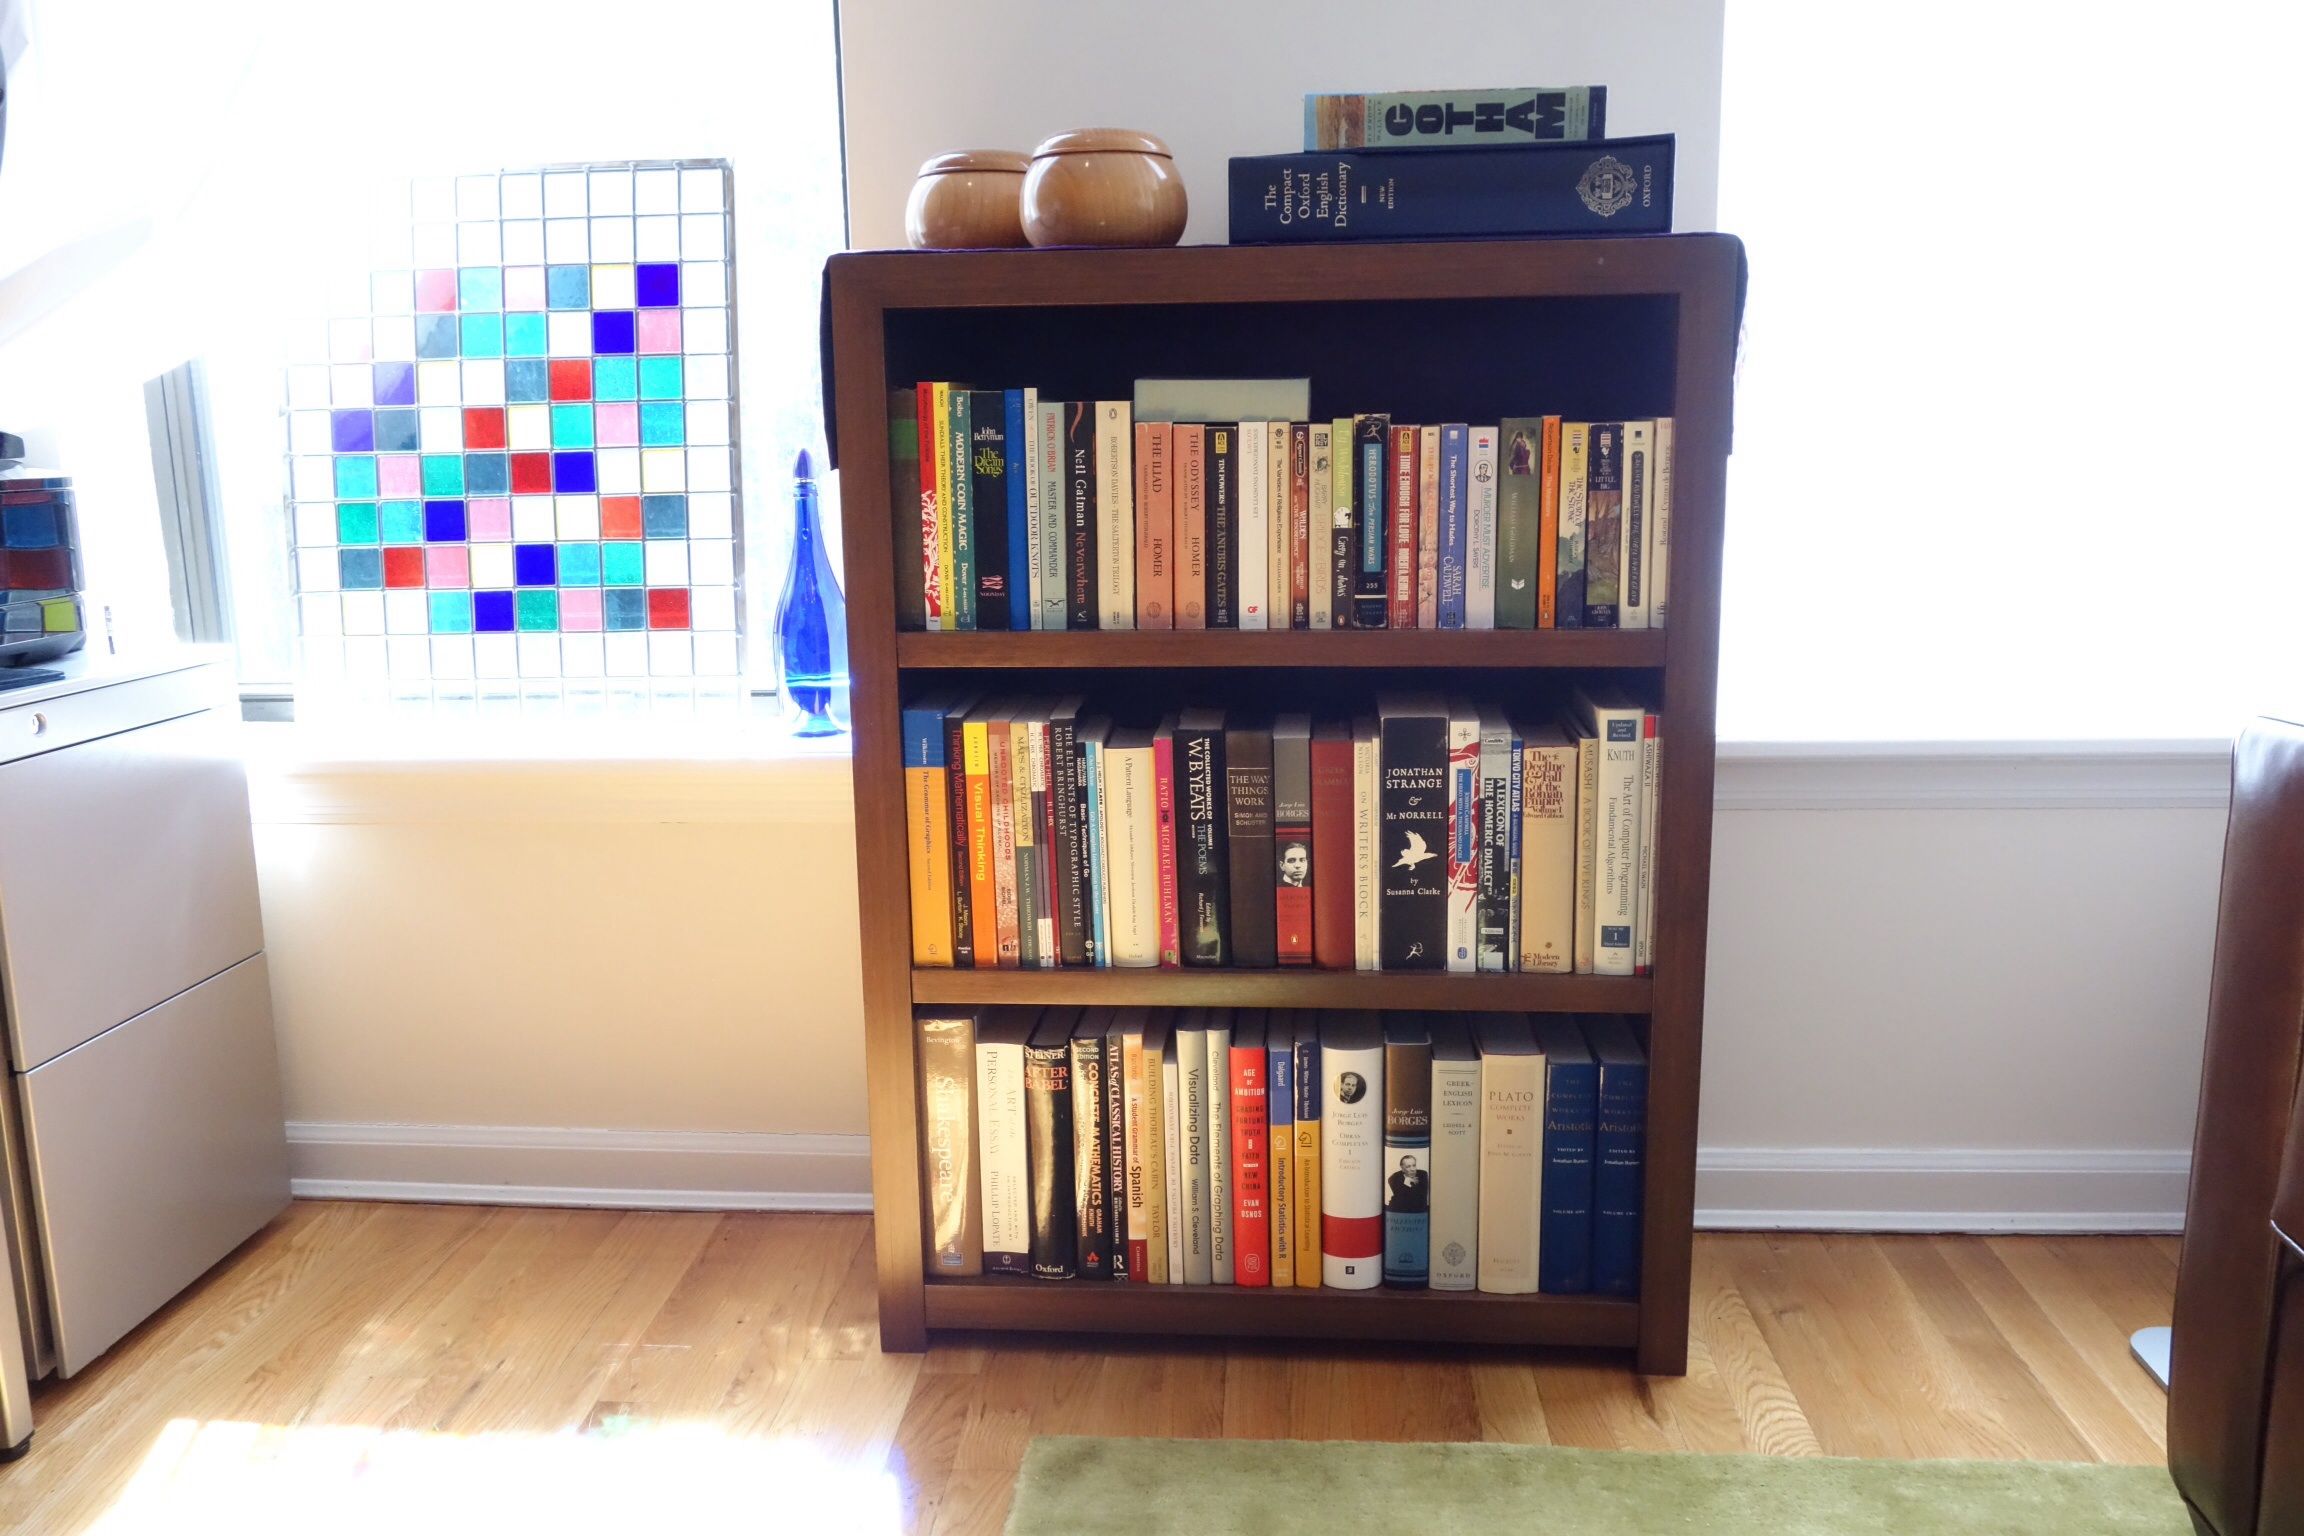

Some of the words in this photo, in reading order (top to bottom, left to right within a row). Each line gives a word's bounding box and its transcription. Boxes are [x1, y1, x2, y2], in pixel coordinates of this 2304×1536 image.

[1385, 92, 1566, 139] GOTHAM
[1265, 185, 1277, 209] The
[1280, 169, 1296, 224] Compact
[1298, 173, 1310, 218] Oxford
[1316, 172, 1332, 218] English
[1335, 162, 1351, 227] Dictionary
[1643, 165, 1652, 207] OXFORD
[956, 396, 964, 417] Bobo
[955, 432, 965, 480] MODERN
[1152, 434, 1162, 459] THE
[1190, 433, 1199, 456] THE
[1074, 449, 1086, 474] Neil
[1152, 461, 1162, 493] ILIAD
[1399, 455, 1410, 474] TIME
[957, 483, 966, 511] COIN
[1048, 481, 1057, 510] MASTER
[1190, 460, 1200, 511] ODYSSEY
[1218, 474, 1226, 504] POWERS
[1399, 474, 1410, 506] ENOUGH
[1568, 481, 1576, 494] THE
[1076, 479, 1087, 527] Gaiman
[1216, 507, 1226, 527] THE
[1399, 509, 1410, 523] FOR
[1448, 501, 1456, 514] Way
[1482, 488, 1492, 525] MURDER
[1567, 496, 1576, 522] STONE
[959, 513, 967, 551] MAGIC
[1049, 513, 1057, 528] AND
[1398, 525, 1410, 544] LOVE
[1216, 529, 1227, 571] ANUBIS
[1482, 527, 1491, 546] MUST
[1049, 531, 1058, 578] COMMANDER
[1076, 532, 1088, 603] Neverwhere
[1153, 538, 1163, 577] HOMER
[1191, 537, 1201, 577] HOMER
[1481, 548, 1490, 589] ADVERTISE
[1217, 572, 1227, 607] GATES
[1442, 556, 1452, 605] CAUDWELL
[1452, 565, 1462, 595] SARAH
[951, 729, 963, 770] Thinking
[1017, 736, 1025, 763] MAPS
[1054, 727, 1064, 767] ROBERT
[1065, 726, 1073, 747] THE
[1188, 739, 1203, 756] W.
[1018, 766, 1025, 774] &
[1188, 761, 1203, 774] B.
[1512, 748, 1521, 771] TOKYO
[1531, 751, 1551, 761] The
[1607, 749, 1635, 761] KNUTH
[1066, 750, 1075, 802] ELEMENTS
[1125, 763, 1134, 786] Pattern
[1230, 776, 1249, 784] THE
[1251, 775, 1270, 783] WAY
[1386, 768, 1443, 779] JONATHAN
[1386, 779, 1442, 789] STRANGE
[1484, 778, 1494, 798] THE
[1497, 779, 1505, 787] A
[1512, 773, 1521, 789] CITY
[1623, 775, 1633, 792] The
[922, 784, 931, 815] Grammar
[974, 782, 984, 822] Visual
[1056, 770, 1067, 837] BRINGHURST
[1125, 787, 1134, 818] Language
[1160, 777, 1169, 808] RATIO
[1189, 775, 1205, 820] YEATS
[1231, 786, 1269, 795] THINGS
[1361, 791, 1367, 805] ON
[1512, 790, 1520, 812] ATLAS
[1623, 793, 1632, 808] Art
[954, 772, 966, 847] Mathematically
[1019, 776, 1030, 842] CIVILIZATION
[1068, 805, 1076, 820] OF
[1399, 812, 1443, 820] NORRELL
[1484, 800, 1494, 845] HOMERIC
[1496, 789, 1505, 831] LEXICON
[1607, 797, 1617, 849] Fundamental
[1623, 809, 1632, 818] of
[924, 825, 933, 854] Graphics
[1160, 824, 1171, 871] MICHAEL
[1197, 825, 1206, 842] THE
[1358, 809, 1369, 871] WRITER'S
[1495, 834, 1504, 847] OF
[1620, 819, 1632, 860] Computer
[975, 827, 986, 881] Thinking
[1068, 822, 1079, 895] TYPOGRAPHIC
[1198, 843, 1207, 874] POEMS
[1483, 848, 1493, 886] DIALECT
[1410, 877, 1419, 886] by
[1606, 851, 1616, 894] Algorithms
[1162, 874, 1173, 924] RUHLMAN
[1359, 875, 1369, 919] BLOCK
[1386, 888, 1415, 896] Susanna
[1617, 862, 1631, 916] Programming
[1072, 897, 1082, 928] STYLE
[1025, 1066, 1068, 1078] AFTER
[1109, 1044, 1120, 1078] ATLAS
[1211, 1051, 1220, 1091] Cleveland
[1243, 1069, 1255, 1077] AGE
[1276, 1061, 1286, 1087] Dalgaard
[1025, 1079, 1067, 1090] BABEL
[1087, 1062, 1099, 1123] CONCRETE
[1109, 1078, 1120, 1087] of
[1147, 1057, 1157, 1105] BUILDING
[1235, 1088, 1265, 1096] AMBITION
[1489, 1091, 1534, 1102] PLATO
[1110, 1087, 1122, 1145] CLASSICAL
[1131, 1103, 1139, 1126] Student
[1188, 1068, 1200, 1133] Visualizing
[1212, 1102, 1222, 1120] The
[1149, 1107, 1159, 1159] THOREAU'S
[1387, 1115, 1428, 1126] BORGES
[931, 1076, 956, 1203] Shakespeare
[1190, 1135, 1200, 1165] Data
[1212, 1122, 1223, 1169] Elements
[1090, 1127, 1102, 1206] MATHEMATICS
[1112, 1146, 1123, 1193] HISTORY
[1150, 1161, 1159, 1190] CABIN
[1213, 1172, 1224, 1182] of
[1277, 1157, 1287, 1202] Introductory
[990, 1170, 999, 1209] PHILLIP
[1129, 1165, 1144, 1208] Spanish
[1191, 1178, 1199, 1205] William
[1151, 1203, 1161, 1239] TAYLOR
[1211, 1185, 1225, 1234] Graphing
[1278, 1203, 1287, 1236] Statistics
[991, 1210, 1001, 1247] LOPATE
[1192, 1215, 1200, 1255] Cleveland
[1215, 1236, 1224, 1261] Data
[1278, 1237, 1287, 1252] with
[1035, 1264, 1064, 1274] Oxford
